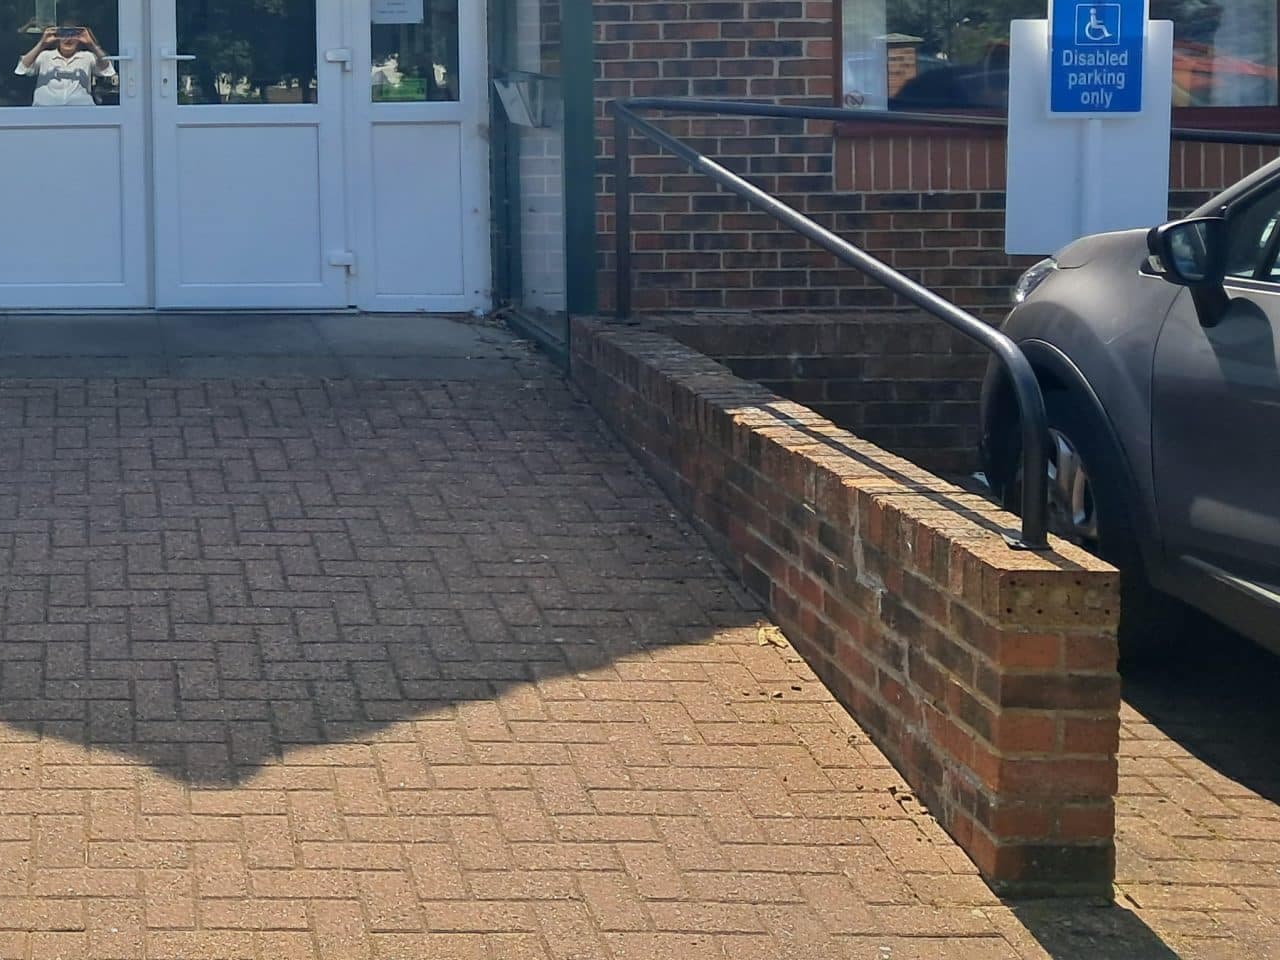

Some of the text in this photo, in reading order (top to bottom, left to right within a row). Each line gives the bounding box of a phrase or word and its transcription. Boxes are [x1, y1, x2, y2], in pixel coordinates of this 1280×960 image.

[1062, 50, 1129, 66] Disabled
[1068, 70, 1125, 89] parking
[1080, 88, 1113, 109] only
